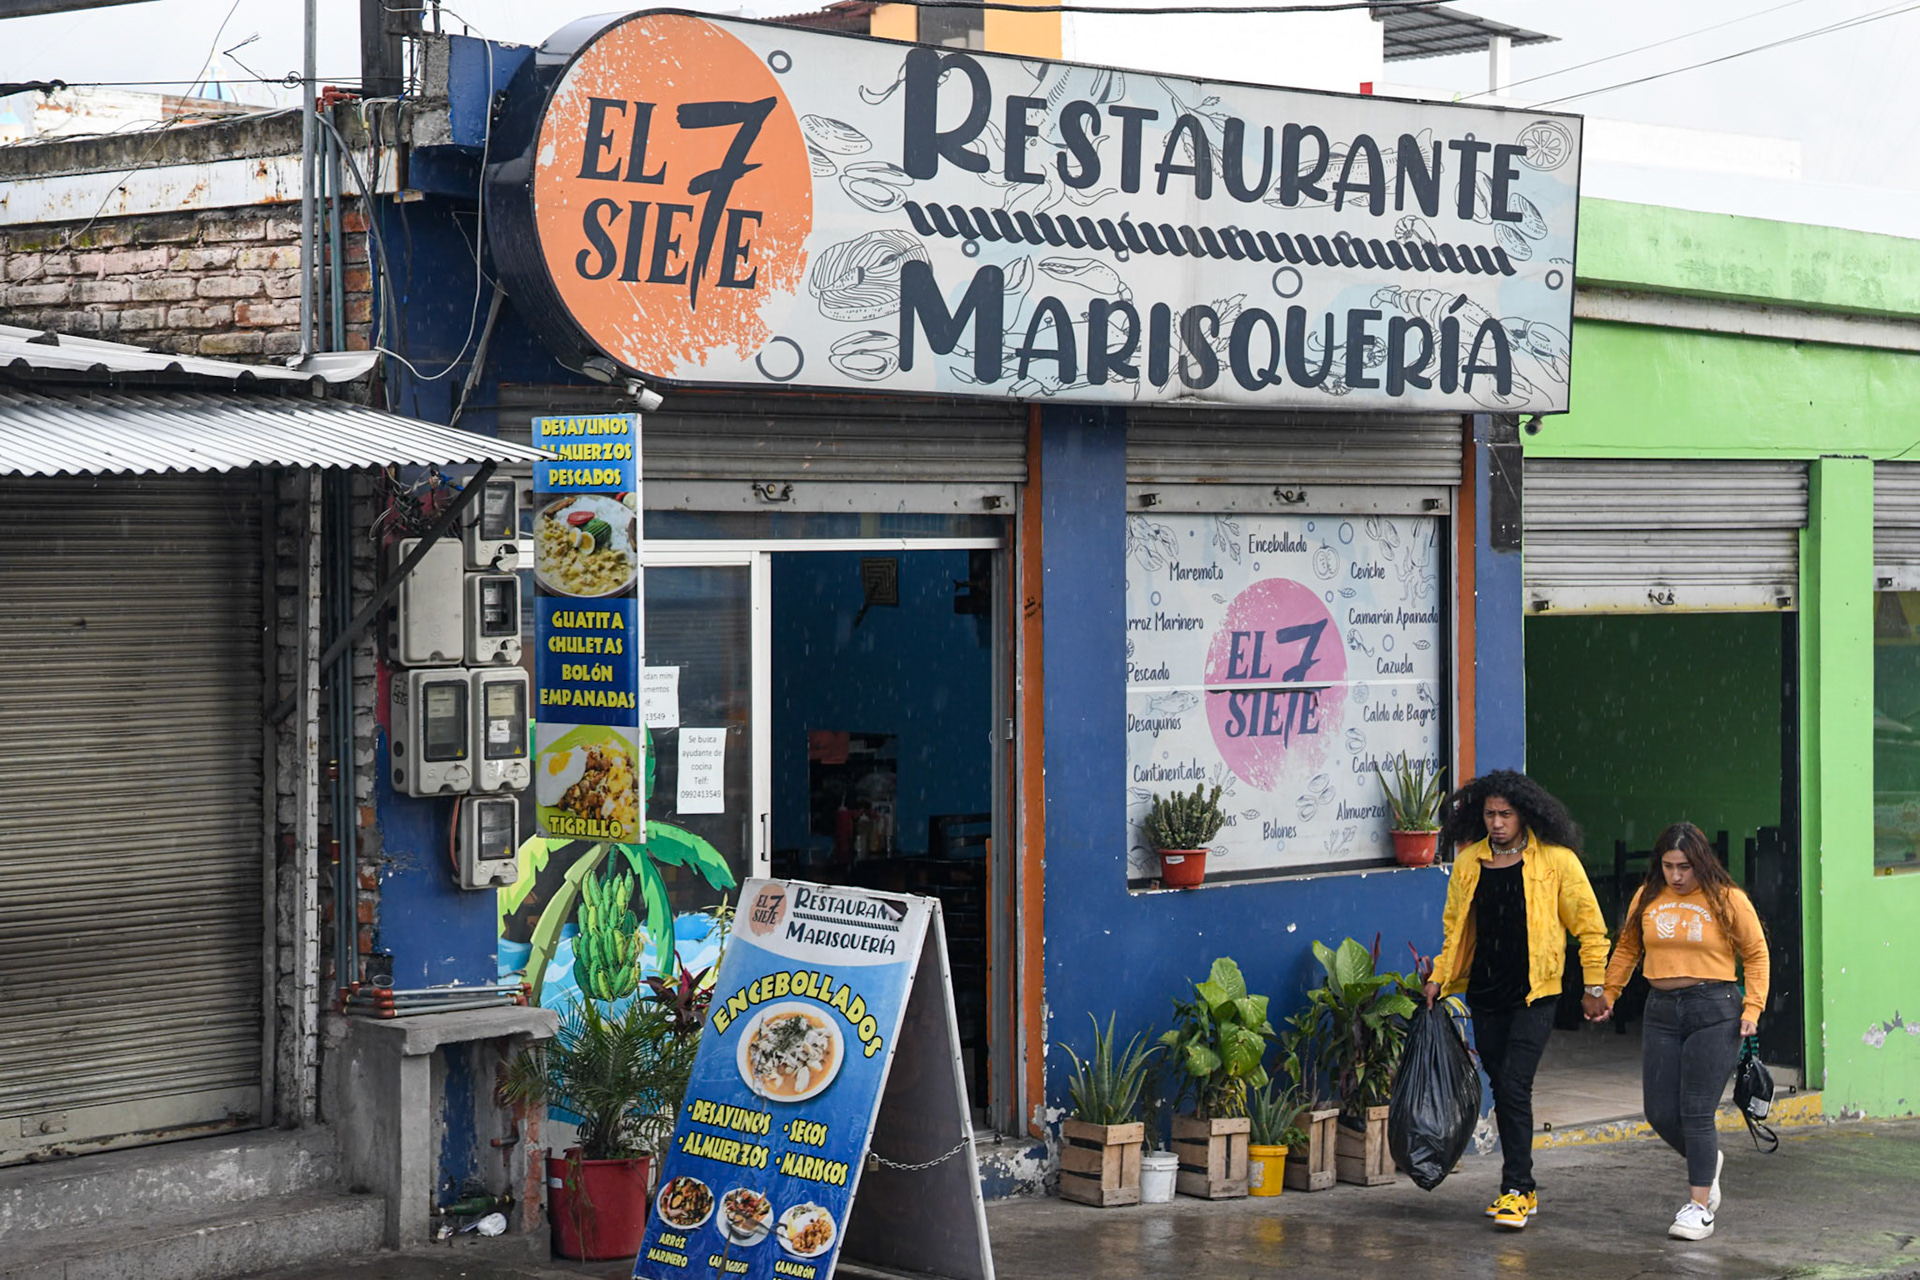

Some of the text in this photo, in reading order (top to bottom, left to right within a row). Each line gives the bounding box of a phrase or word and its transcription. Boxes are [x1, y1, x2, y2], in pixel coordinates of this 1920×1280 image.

[902, 47, 1527, 223] RESTAURANTE
[576, 96, 776, 311] EL 7
[899, 259, 1513, 396] MARISQUERÍA
[541, 417, 628, 435] DESAYUNOS
[549, 468, 621, 486] PESCADOS
[1249, 533, 1307, 554] Encebollado
[1169, 561, 1223, 581] Maremoto
[1351, 561, 1385, 579] Ceviche
[551, 610, 624, 629] GUATITA
[1126, 611, 1203, 631] rroz Marinero
[1349, 605, 1438, 630] Camarón Apanado
[548, 636, 623, 654] CHULETAS
[562, 662, 613, 682] BOLÓN
[1126, 661, 1169, 682] Pescado
[1377, 653, 1413, 674] Cazuela
[1225, 618, 1328, 749] EL 7
[540, 688, 635, 709] EMPANADAS
[1363, 701, 1436, 727] Caldo de Bagre
[1128, 714, 1181, 738] Desayunos
[688, 735, 717, 744] Se busca
[682, 749, 722, 758] ayudante de
[1382, 754, 1394, 773] de
[691, 763, 712, 771] cocina
[1134, 758, 1205, 782] Continentales
[694, 777, 709, 785] Telf:
[680, 789, 721, 799] 0992413549
[1336, 800, 1385, 821] Almuerzos
[549, 815, 622, 838] TIGRILLO
[1263, 818, 1297, 840] Bolones
[756, 894, 767, 908] EL
[794, 887, 895, 922] RESTAURAN
[785, 921, 896, 955] MARISQUERÍA
[711, 970, 884, 1059] ENCEBOLLADOS
[691, 1098, 829, 1148] DESAYUNOS SECOS
[681, 1131, 849, 1188] ALMUERZOS MARISCOS
[647, 1247, 688, 1268] MARINERO
[775, 1259, 816, 1280] CAMARÓN
